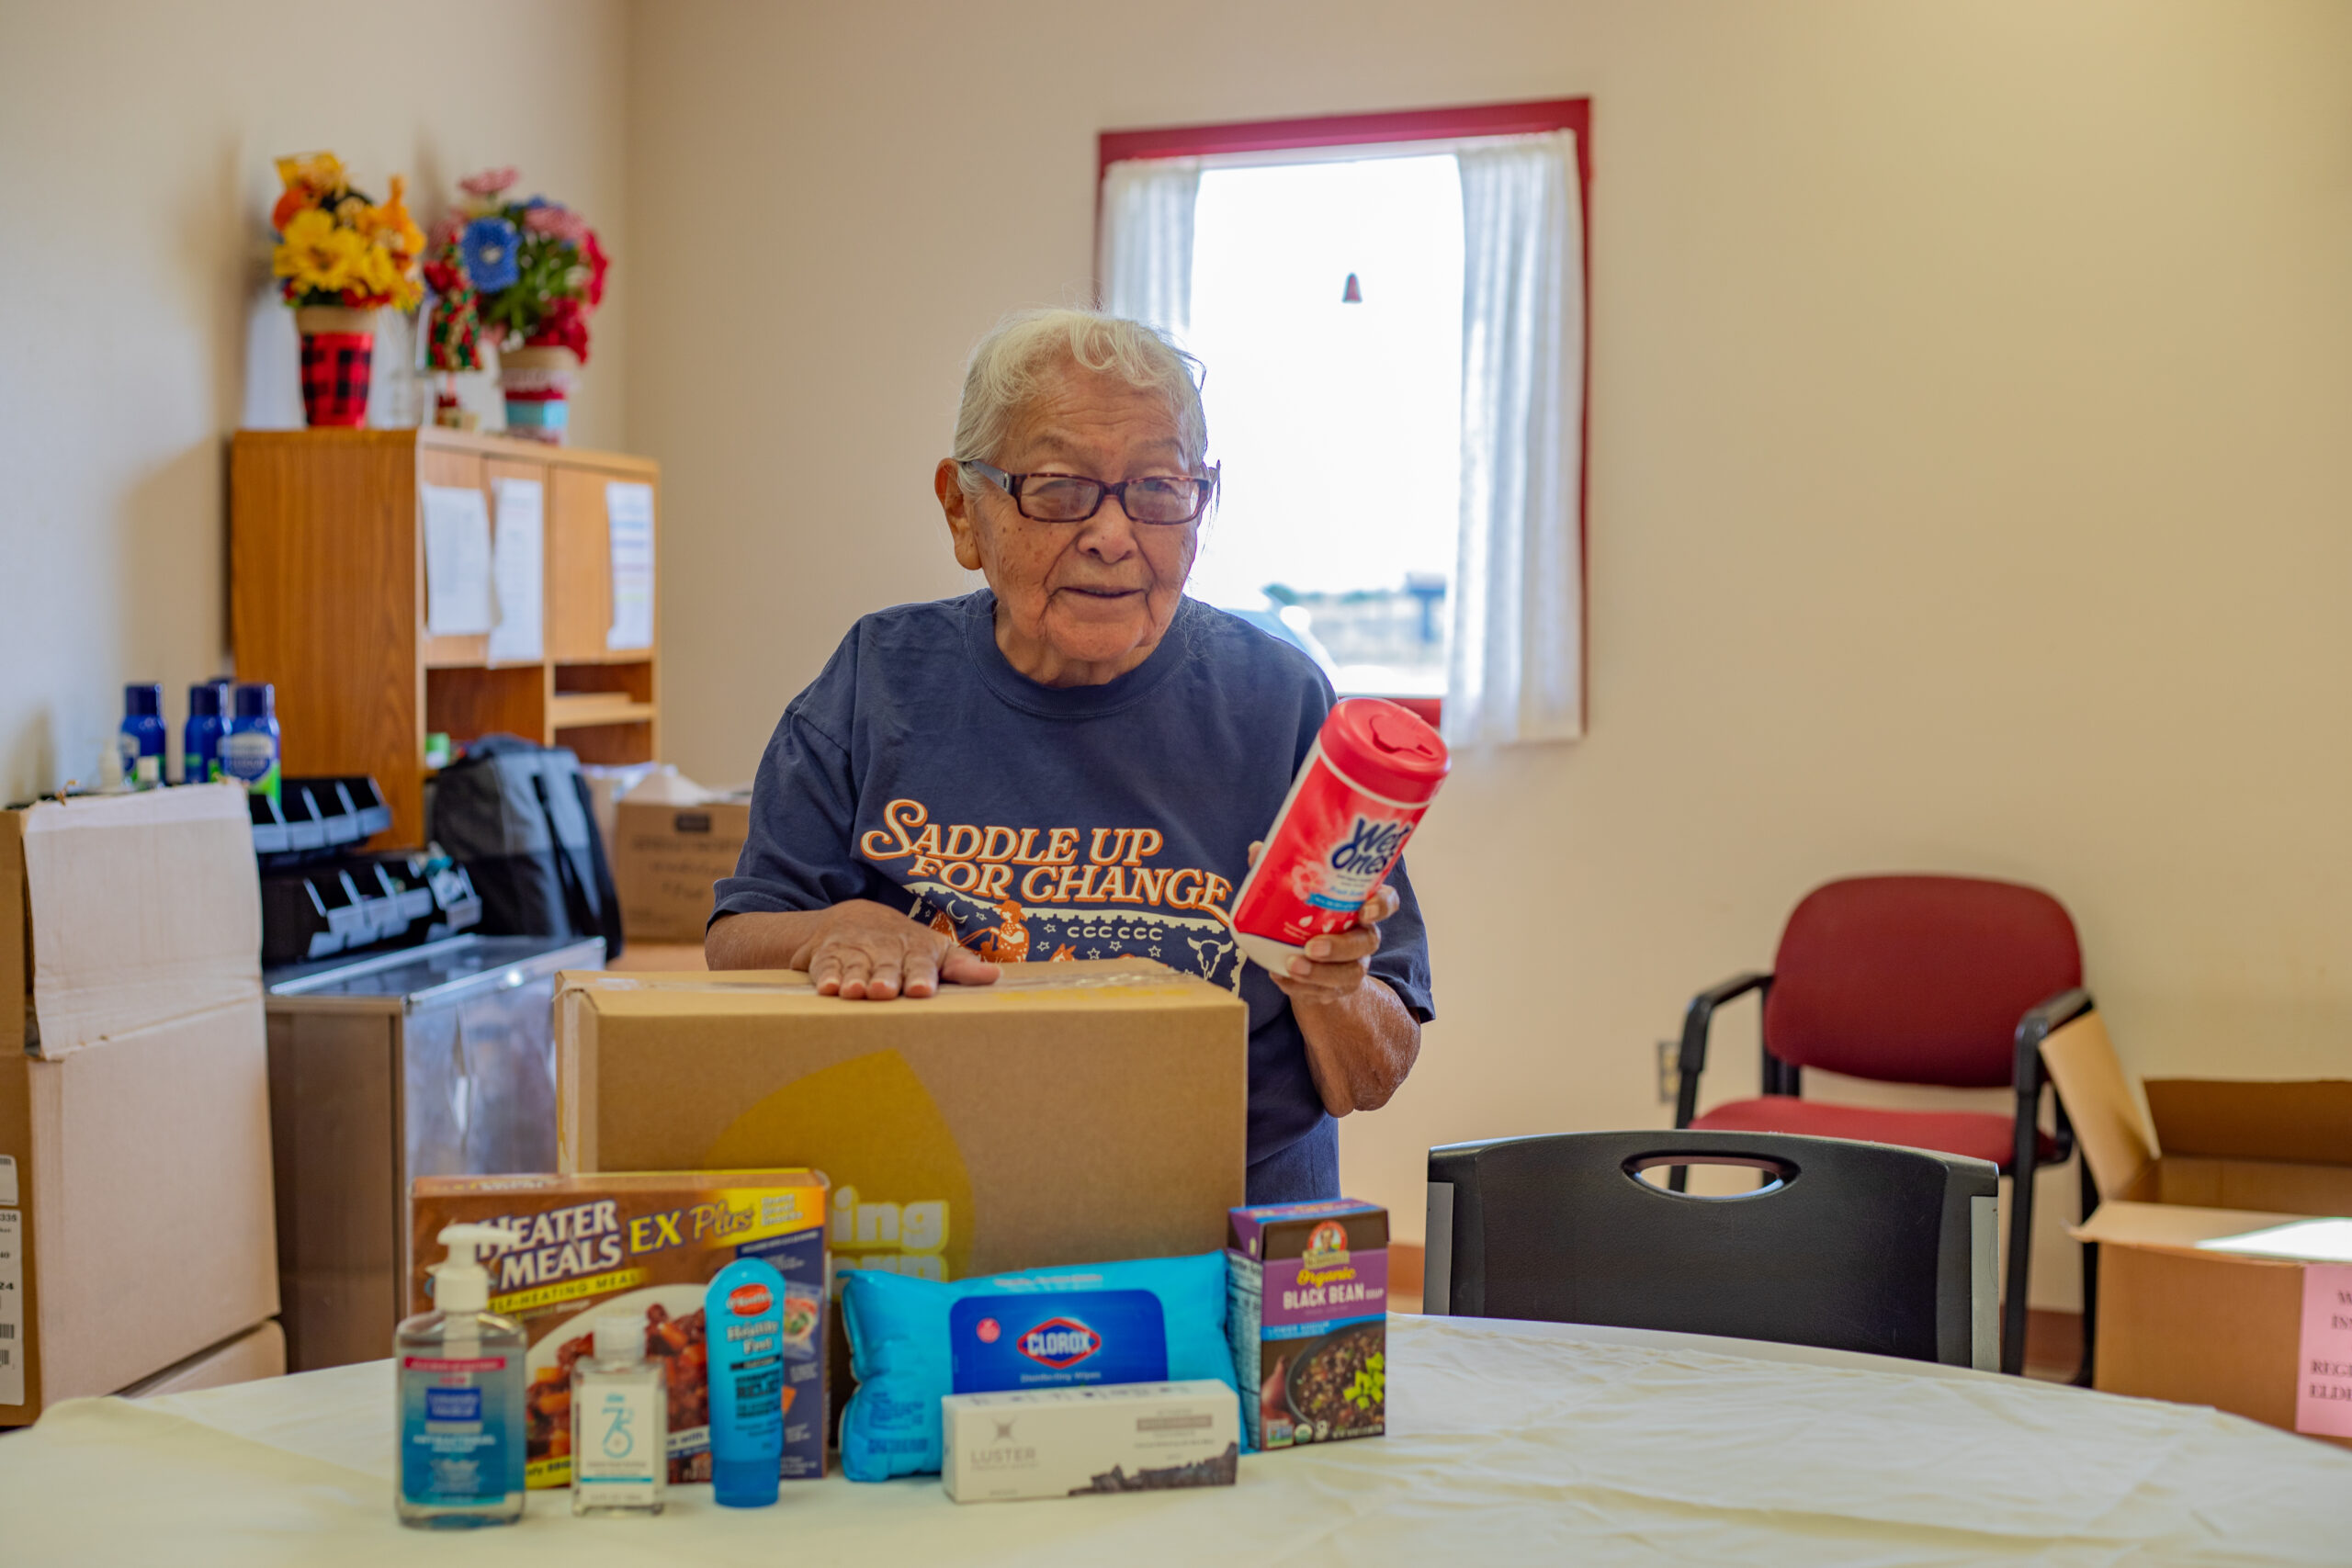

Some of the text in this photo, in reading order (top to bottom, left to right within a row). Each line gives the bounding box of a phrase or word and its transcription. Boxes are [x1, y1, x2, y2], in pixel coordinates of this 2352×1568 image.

[860, 798, 1163, 866] SADDLE UP
[1352, 818, 1409, 854] Wet
[1331, 842, 1394, 875] Ones
[908, 855, 1233, 926] FOR CHANGE
[628, 1211, 684, 1256] EX
[689, 1200, 755, 1240] Plus
[500, 1235, 623, 1291] MEALS
[489, 1282, 588, 1312] ELF-HEATING
[1283, 1288, 1326, 1310] BLACK
[1329, 1282, 1364, 1303] BEAN
[1026, 1331, 1091, 1357] CLOROX
